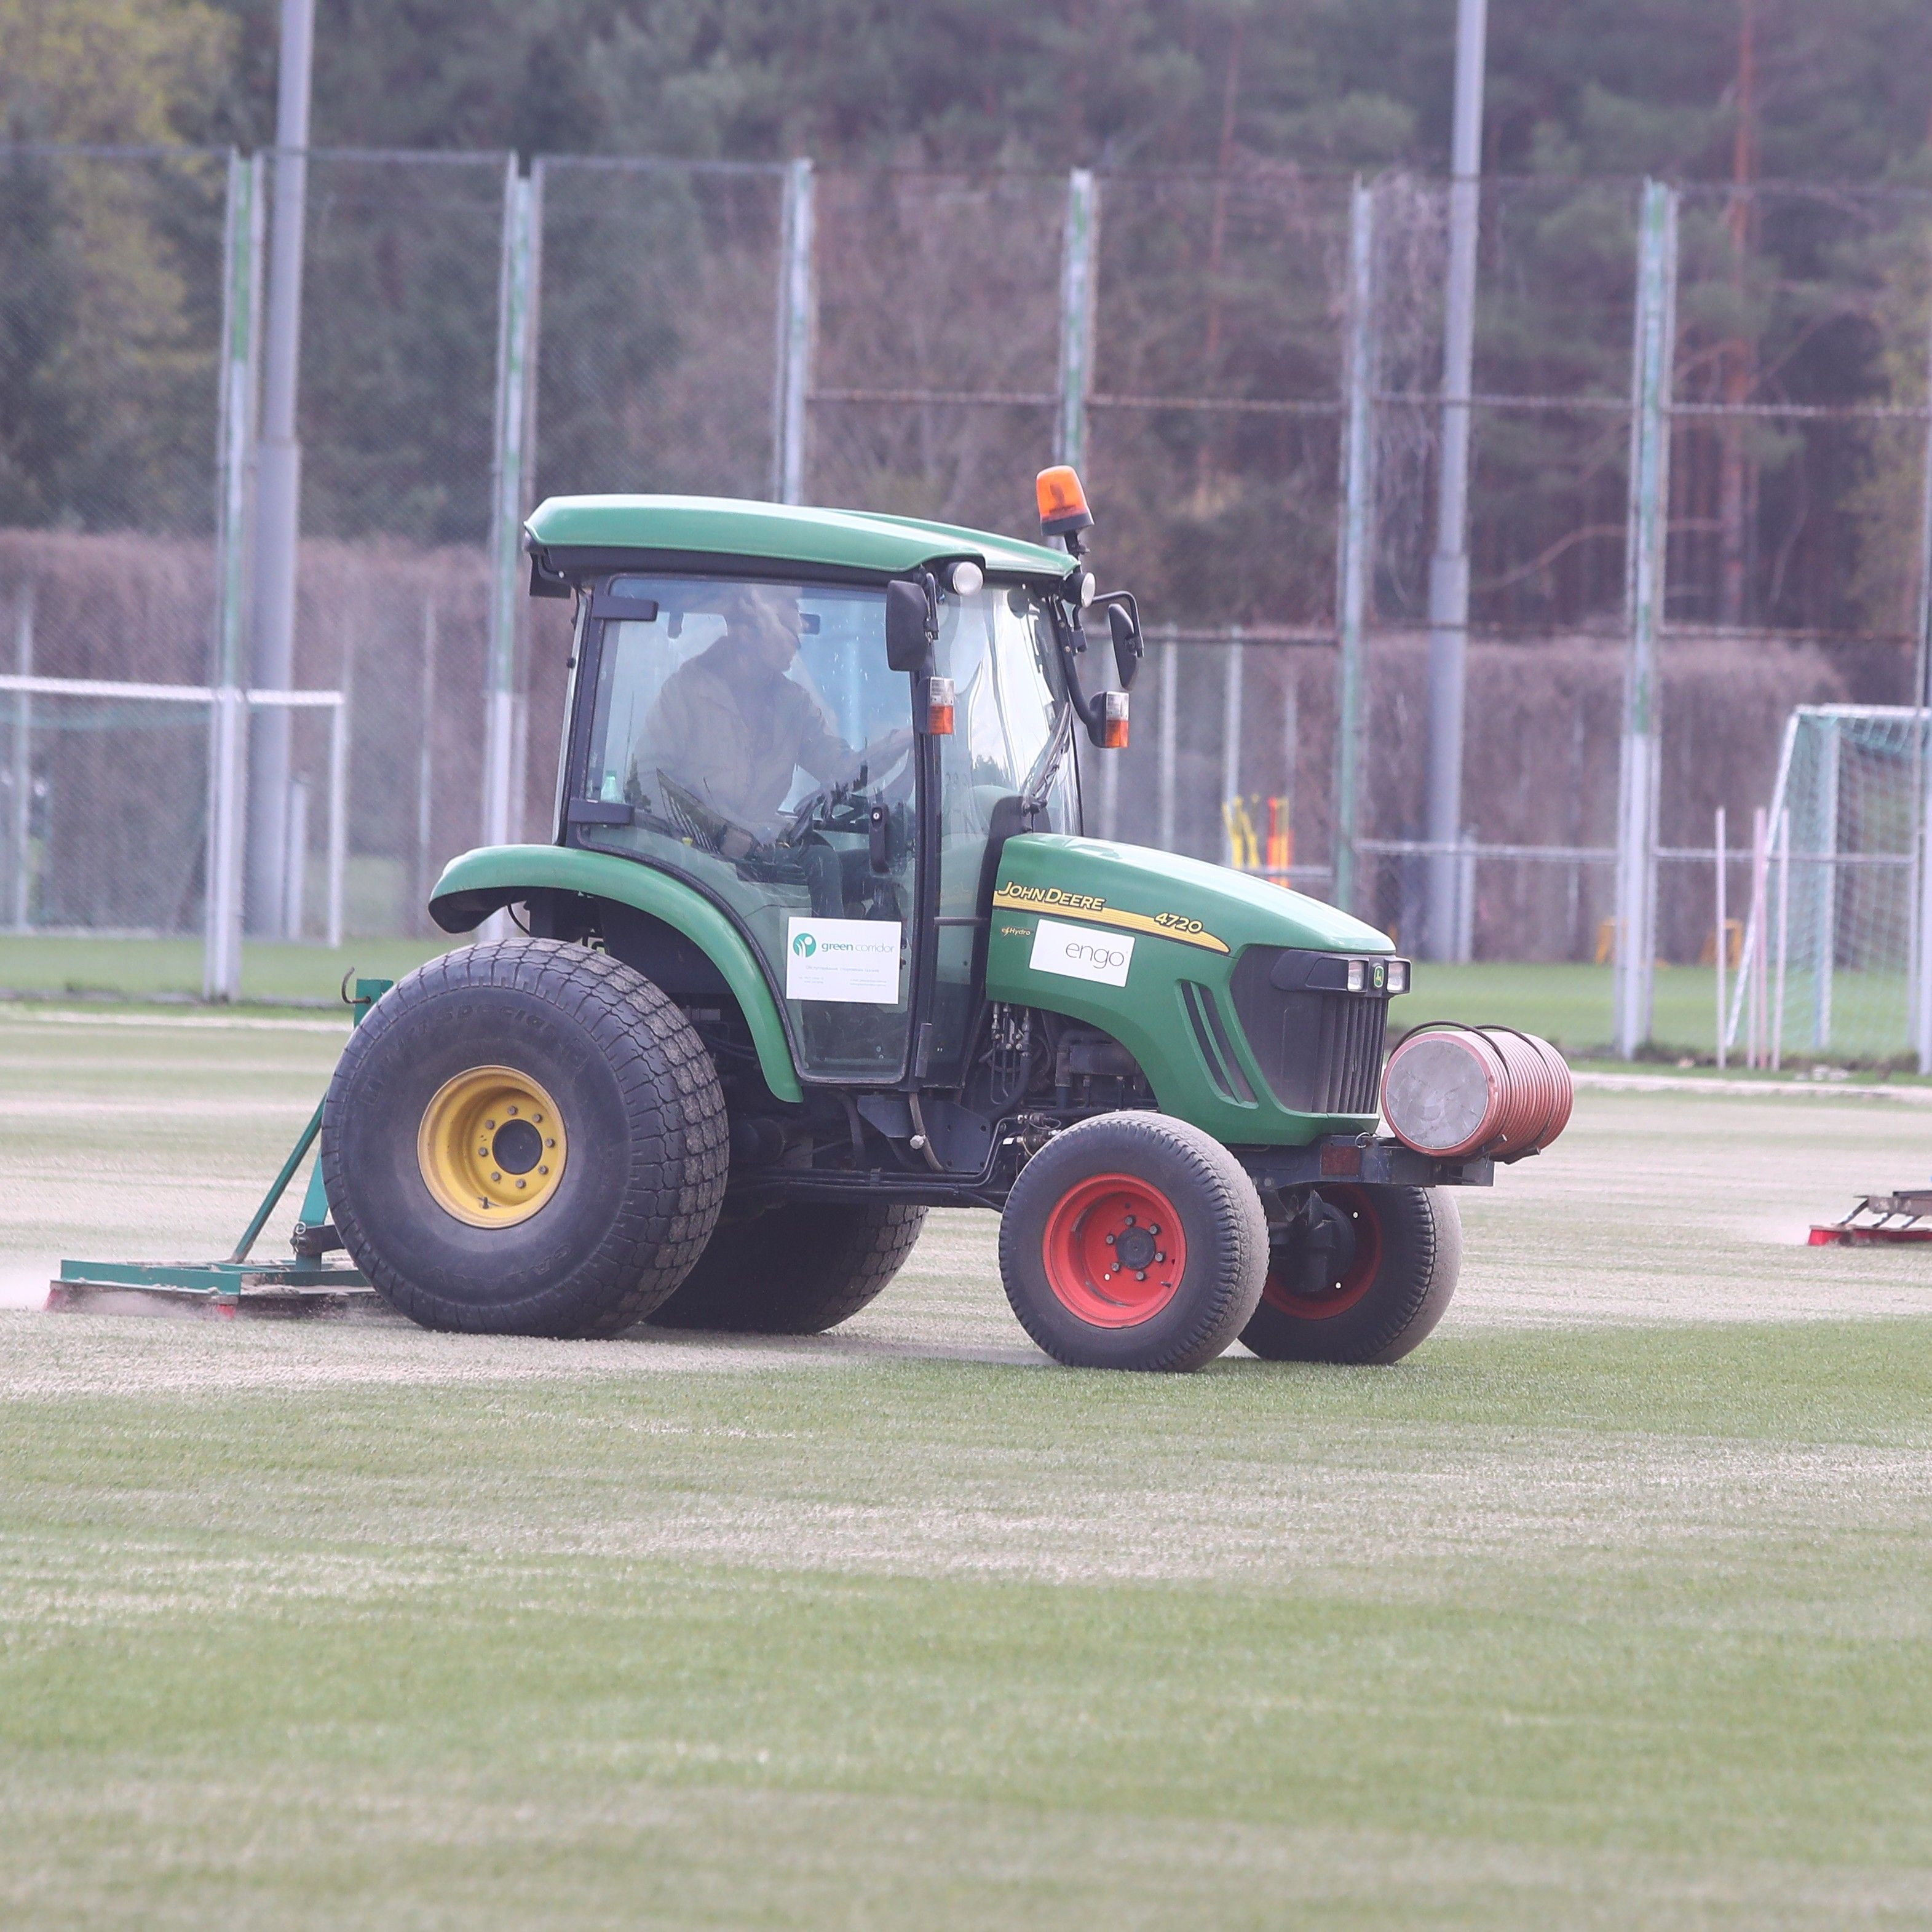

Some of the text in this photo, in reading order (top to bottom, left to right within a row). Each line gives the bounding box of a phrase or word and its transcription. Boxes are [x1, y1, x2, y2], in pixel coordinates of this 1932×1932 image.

[1154, 912, 1203, 934] 4720
[821, 943, 894, 952] green corridor
[1066, 942, 1124, 968] engo
